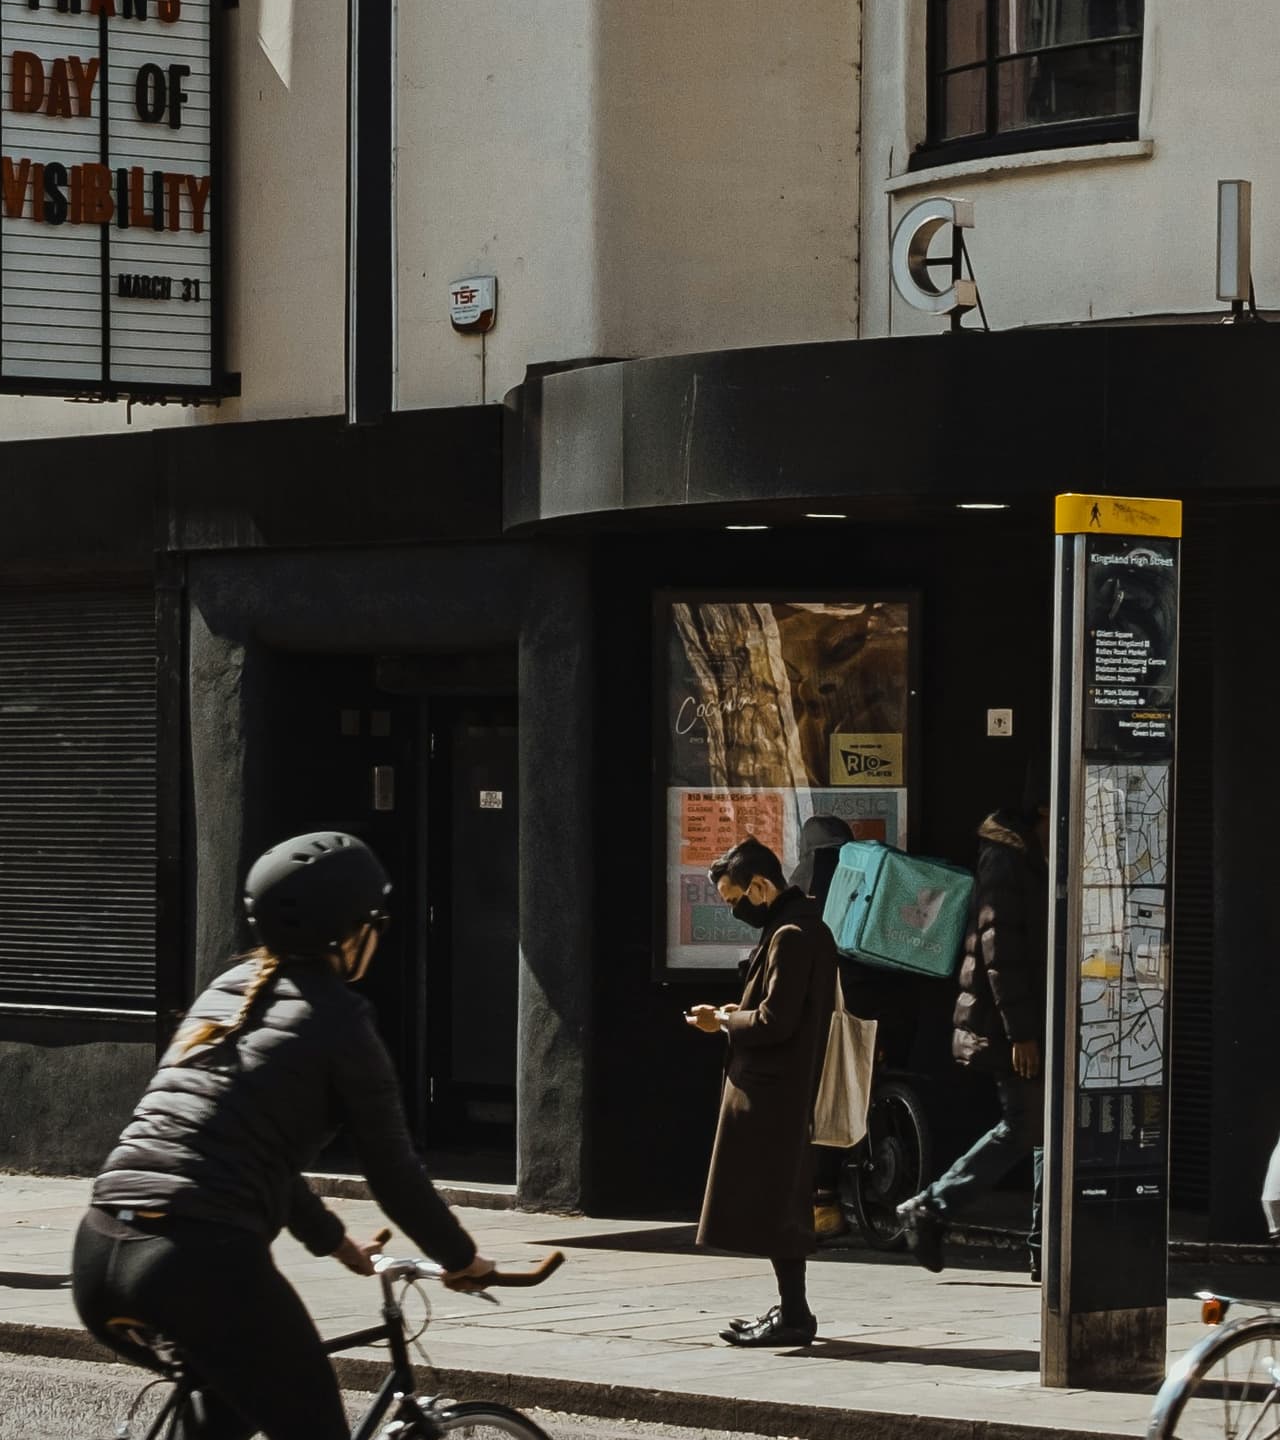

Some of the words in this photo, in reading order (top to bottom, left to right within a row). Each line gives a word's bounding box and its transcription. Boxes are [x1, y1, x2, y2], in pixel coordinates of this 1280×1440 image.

[11, 50, 100, 119] DAY
[134, 61, 192, 130] OF
[0, 156, 211, 234] VISIBILITY
[117, 273, 171, 301] MARCH
[181, 277, 201, 303] 31
[451, 288, 480, 305] TSF
[847, 754, 881, 772] RIO
